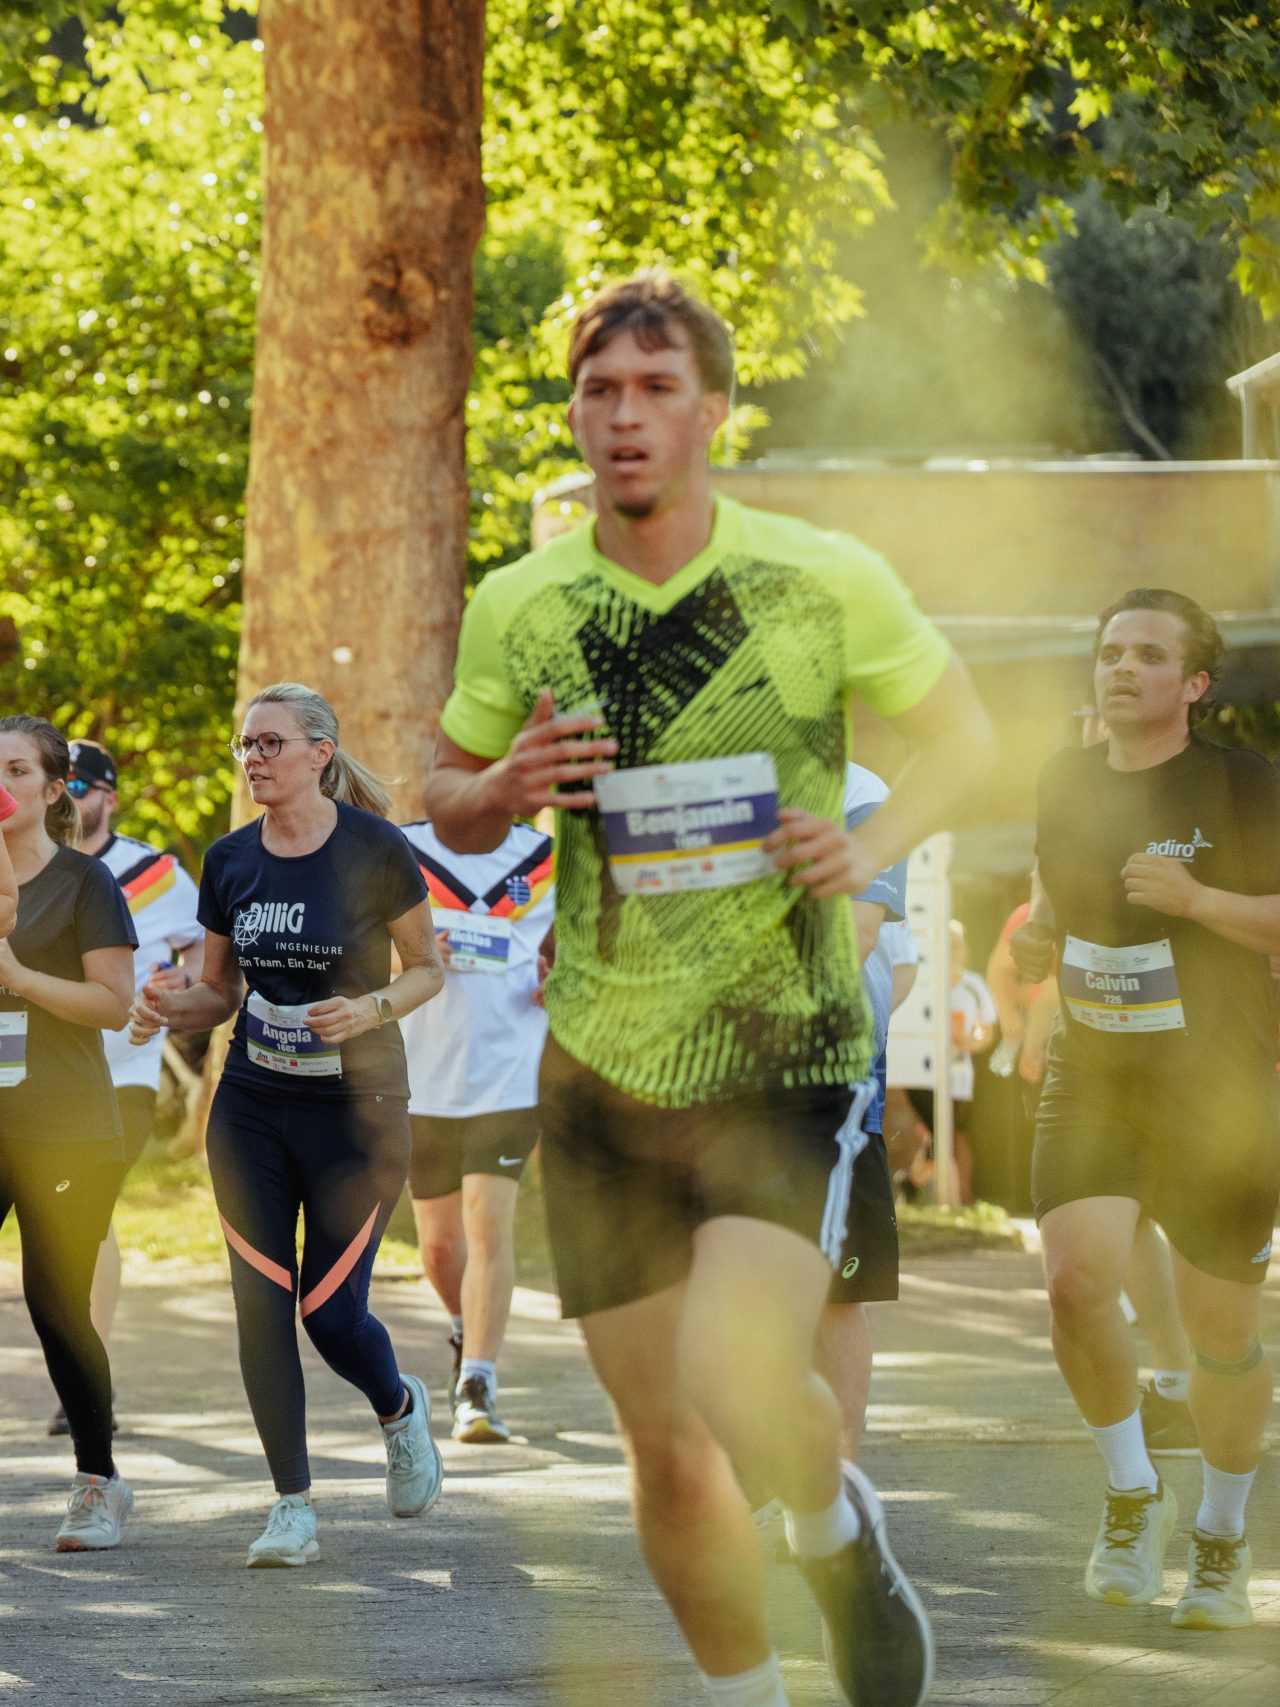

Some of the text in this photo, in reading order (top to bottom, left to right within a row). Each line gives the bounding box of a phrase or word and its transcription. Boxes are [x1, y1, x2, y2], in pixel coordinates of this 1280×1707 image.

[627, 798, 754, 835] Benjamin
[1146, 839, 1195, 857] adiro
[276, 942, 343, 955] INGENIEURE
[253, 957, 285, 968] Team.
[287, 958, 304, 968] Ein
[1085, 971, 1140, 991] Calvin
[262, 1022, 312, 1045] Angela
[277, 1043, 296, 1053] 1682
